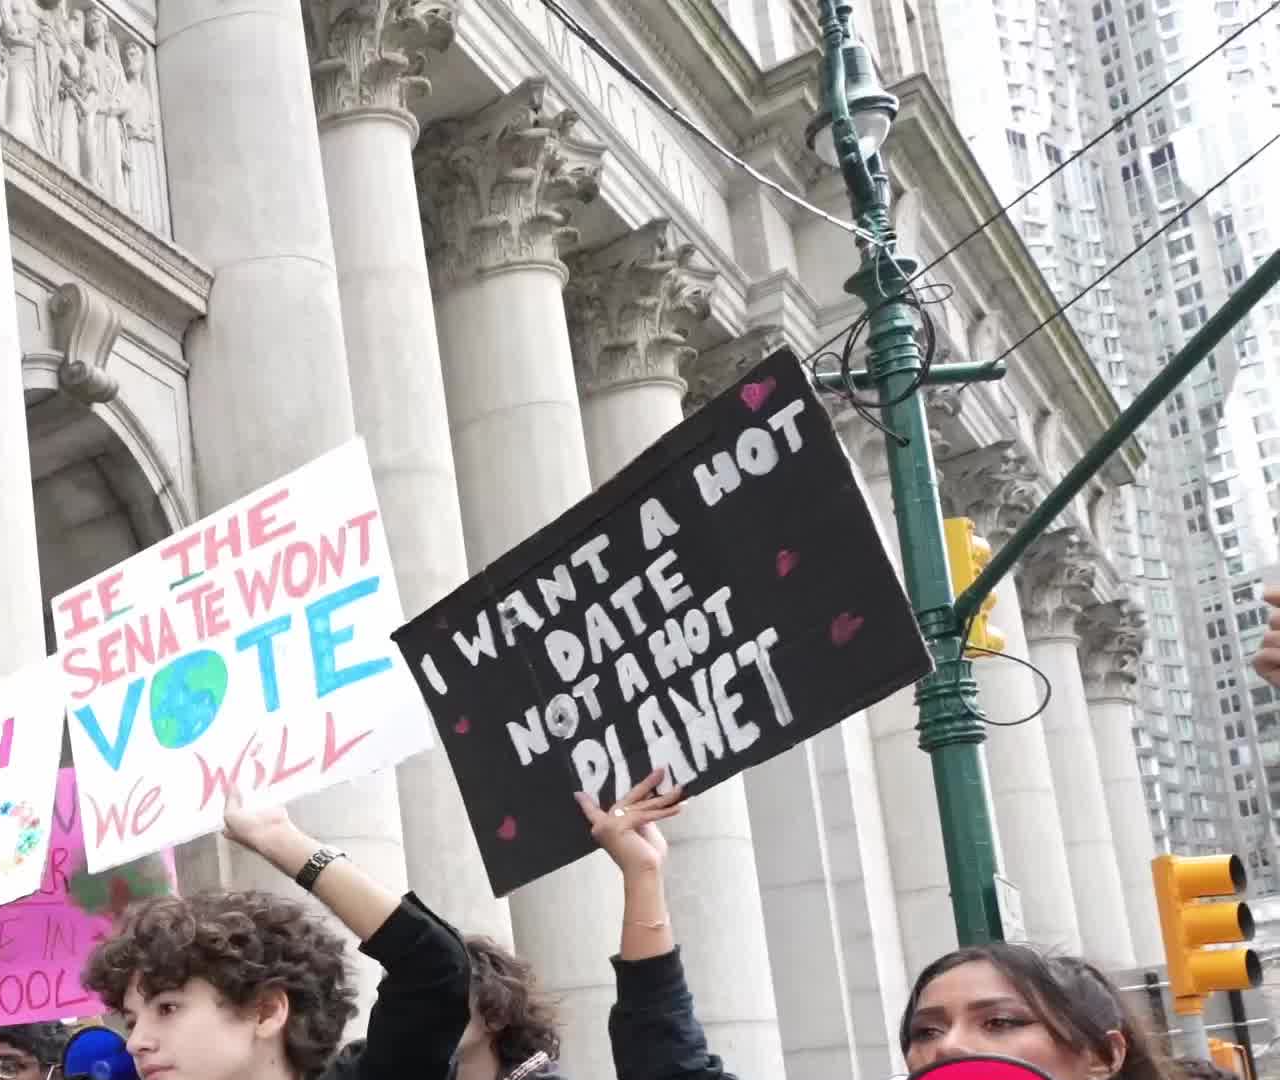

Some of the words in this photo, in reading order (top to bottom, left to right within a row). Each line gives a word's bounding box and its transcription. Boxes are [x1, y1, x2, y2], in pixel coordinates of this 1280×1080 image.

[62, 582, 230, 699] SENATE
[235, 511, 377, 618] WONT
[161, 489, 296, 590] THE
[420, 655, 448, 694] I
[455, 534, 610, 666] WANT
[639, 498, 679, 550] A
[693, 399, 804, 506] HOT
[545, 549, 693, 682] DATE
[506, 675, 602, 766] NOT
[616, 653, 650, 702] A
[648, 586, 737, 680] HOT
[571, 627, 794, 806] PLANET
[42, 915, 78, 961] IN
